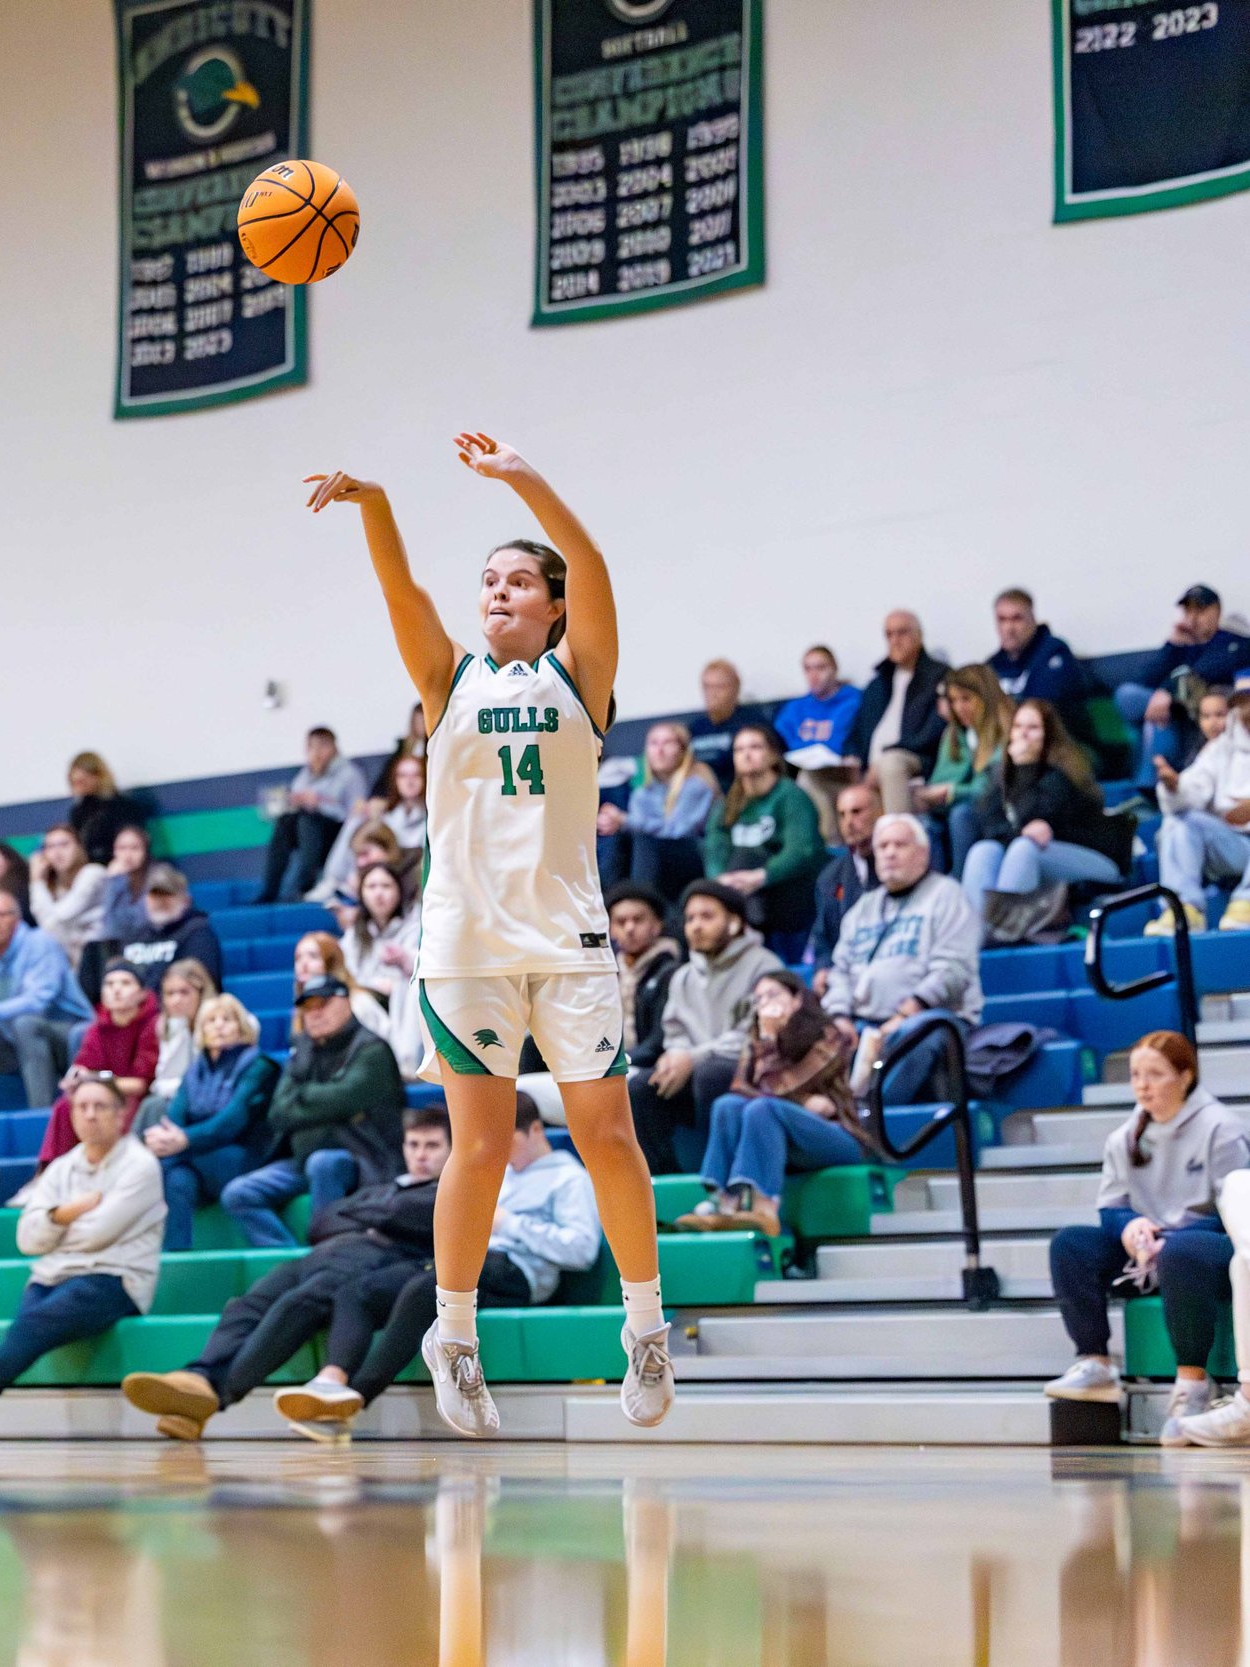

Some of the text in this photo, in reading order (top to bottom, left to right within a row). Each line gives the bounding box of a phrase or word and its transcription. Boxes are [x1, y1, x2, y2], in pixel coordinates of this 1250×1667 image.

[1152, 2, 1219, 41] 2023
[477, 707, 559, 735] GULLS
[497, 744, 546, 796] 14
